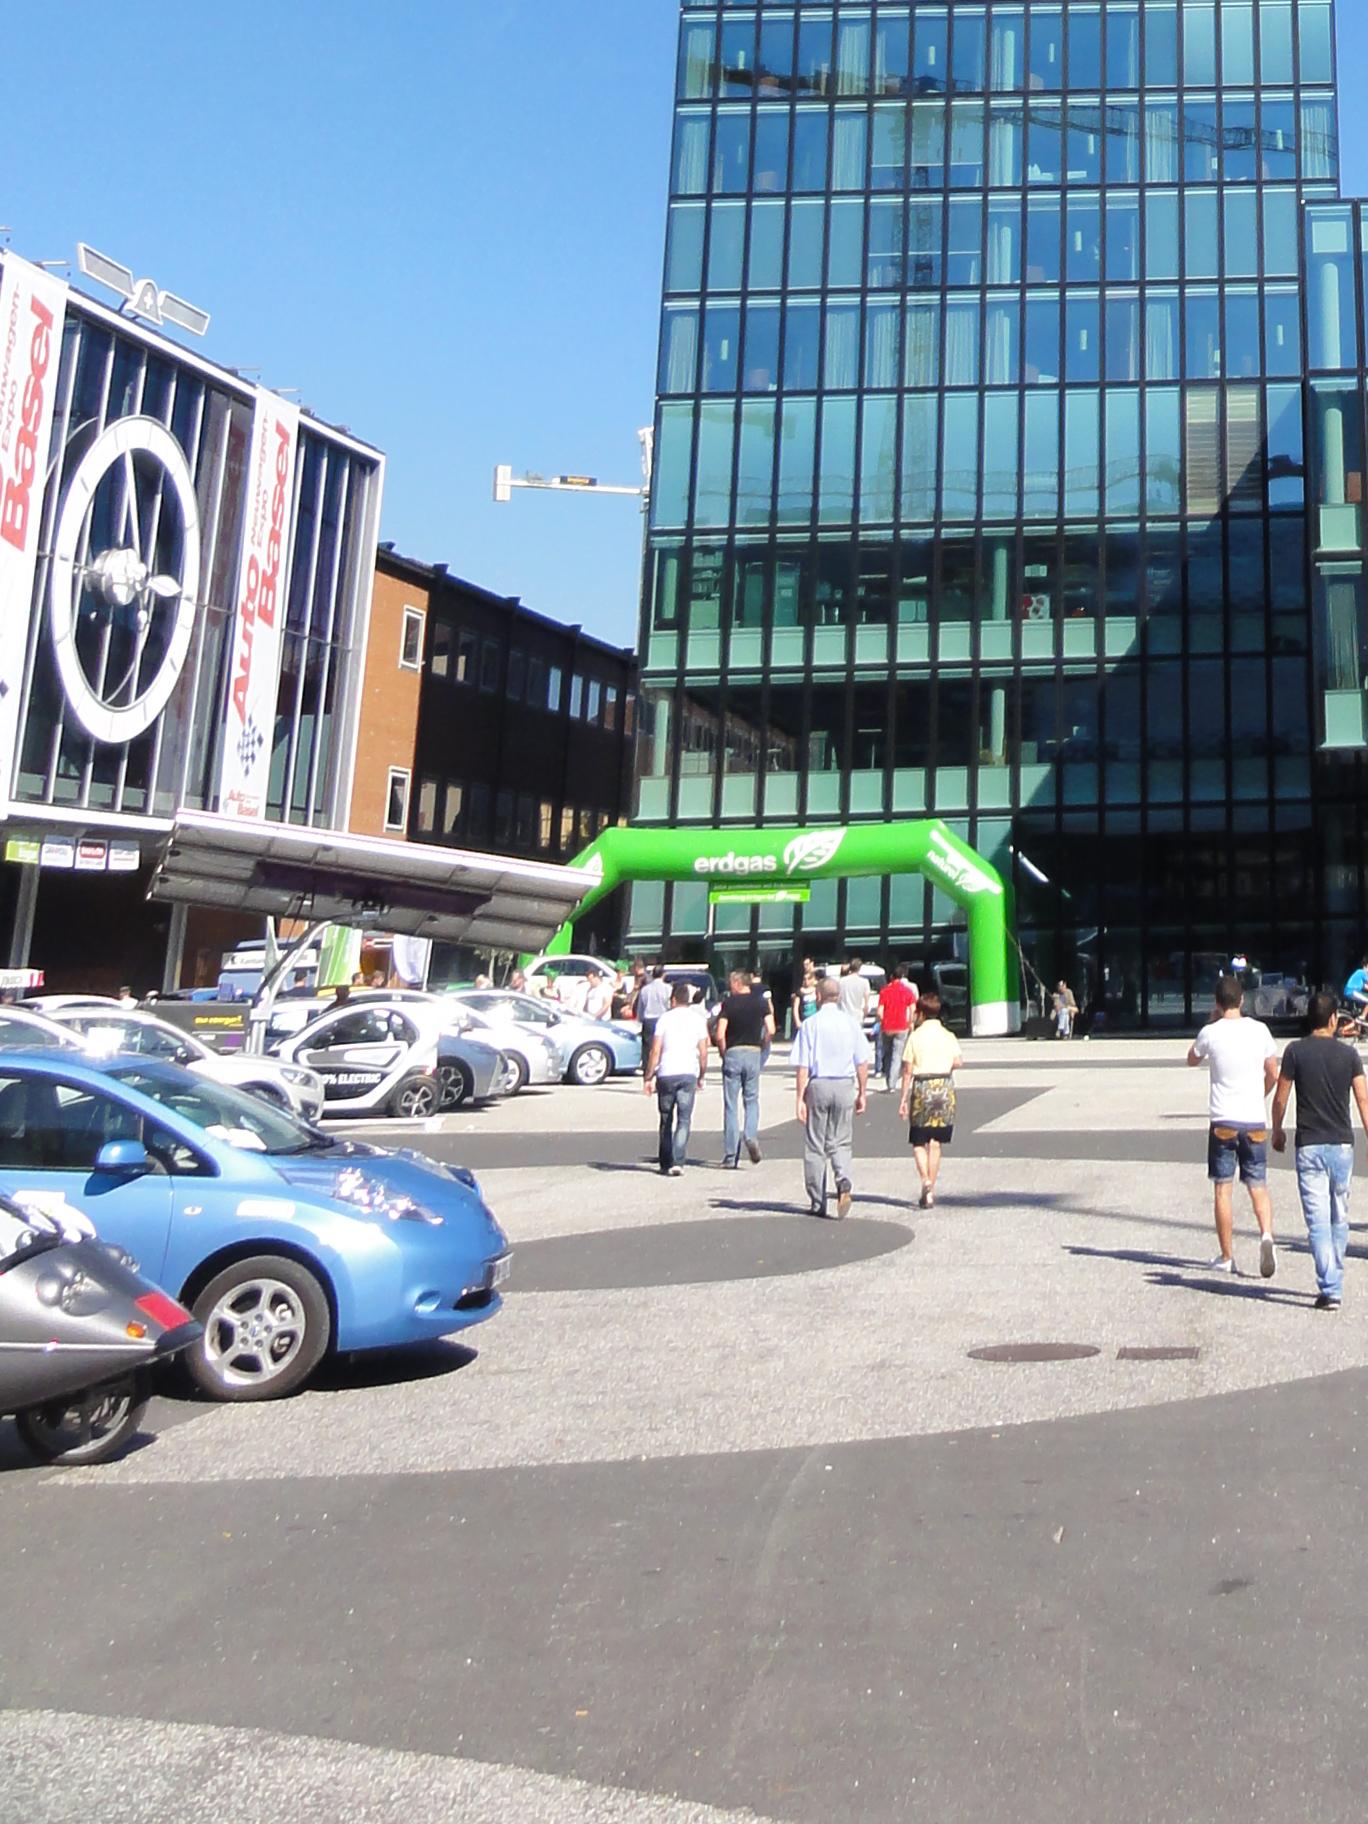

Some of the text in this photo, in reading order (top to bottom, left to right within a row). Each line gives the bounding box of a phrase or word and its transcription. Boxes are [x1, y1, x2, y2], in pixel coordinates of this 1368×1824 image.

[0, 293, 54, 552] Basel
[1, 380, 17, 453] Expo
[257, 418, 291, 628] Basel
[233, 553, 259, 725] Auto
[694, 851, 777, 875] erdgas
[338, 1073, 381, 1085] ELECTRIC
